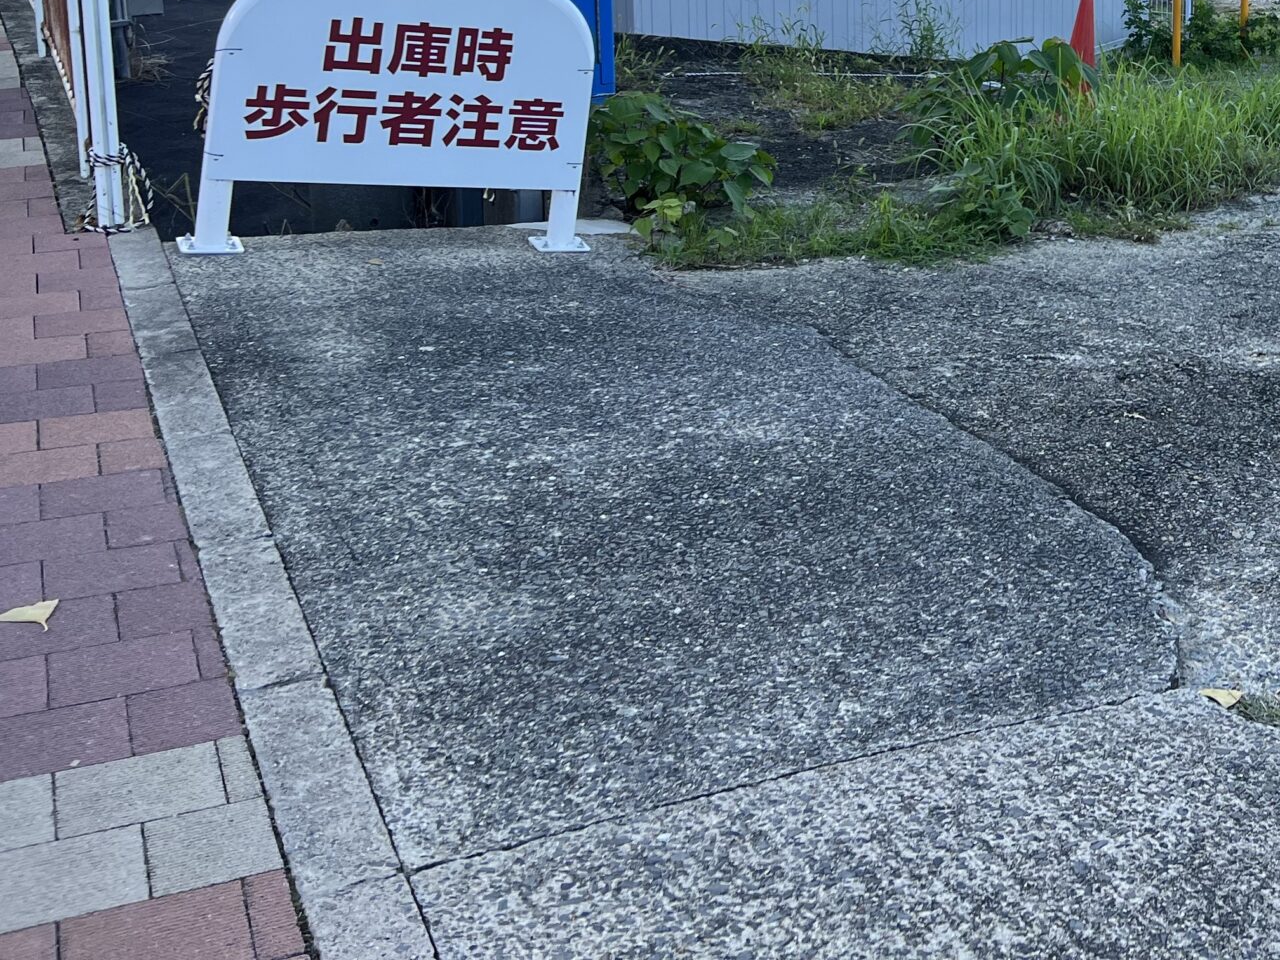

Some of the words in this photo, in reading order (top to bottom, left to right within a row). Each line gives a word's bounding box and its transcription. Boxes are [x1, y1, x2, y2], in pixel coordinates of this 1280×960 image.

[322, 17, 514, 82] 出庫時
[244, 84, 564, 152] 歩行者注意
